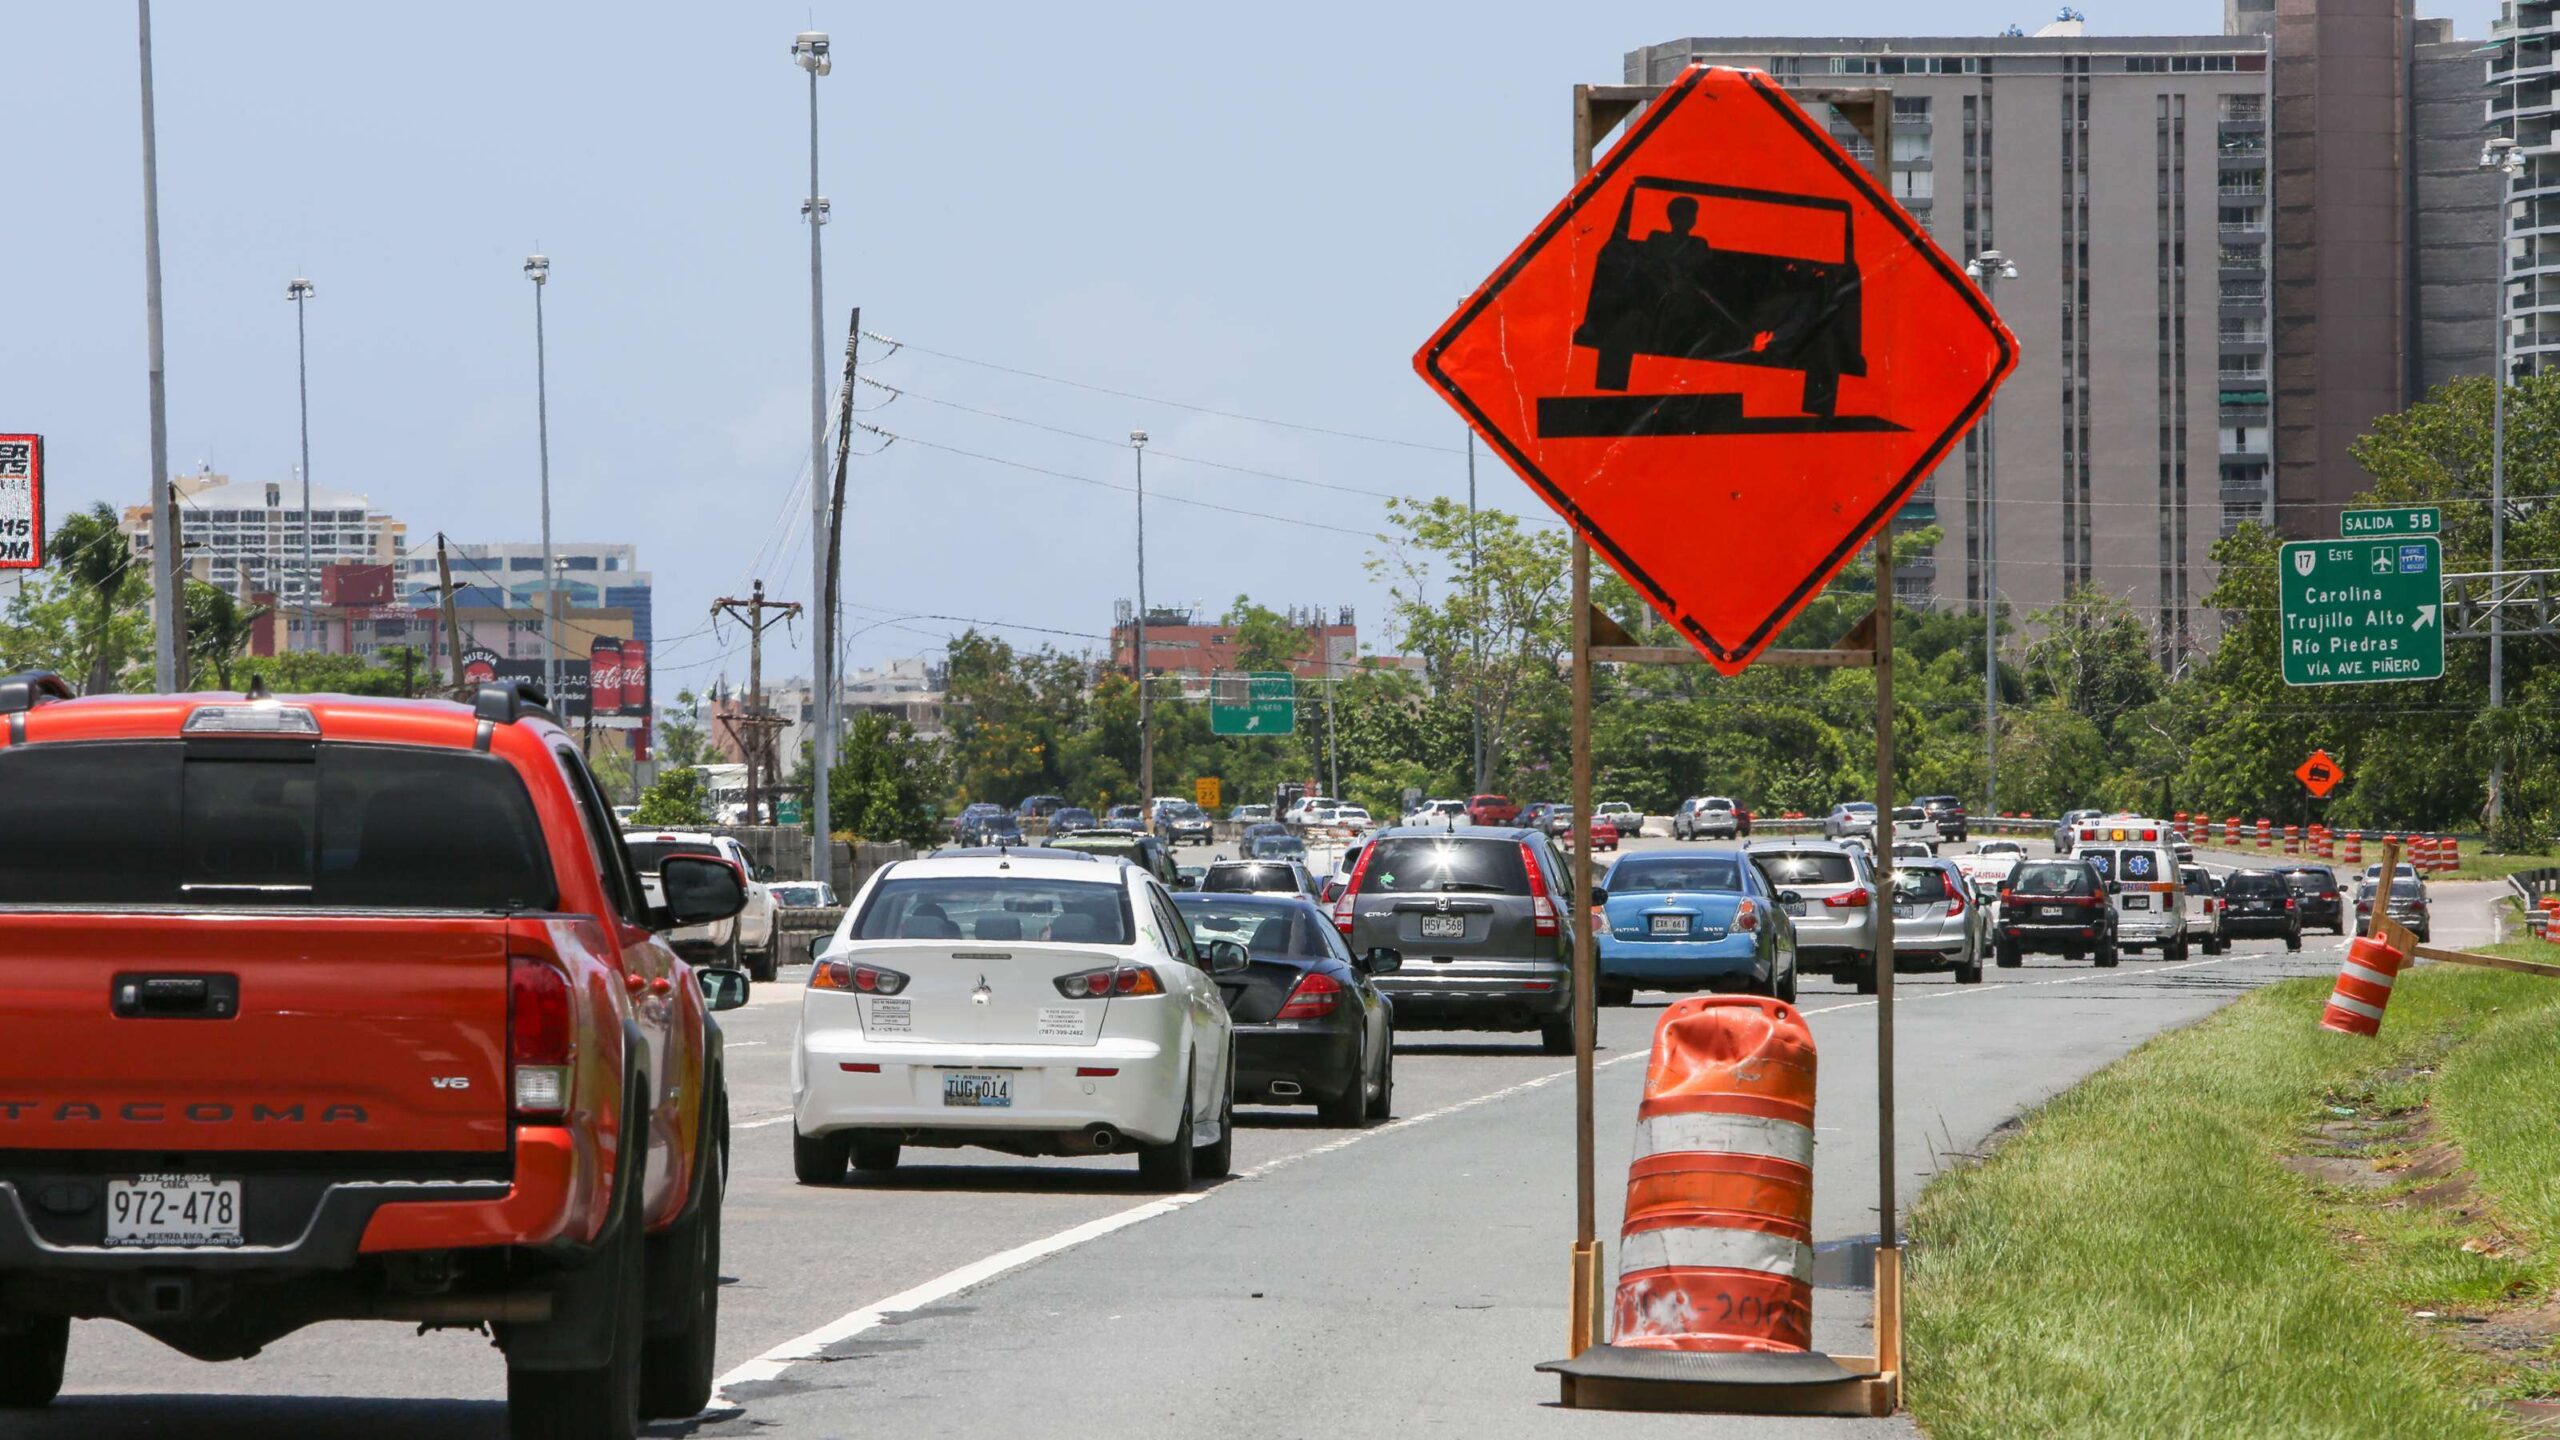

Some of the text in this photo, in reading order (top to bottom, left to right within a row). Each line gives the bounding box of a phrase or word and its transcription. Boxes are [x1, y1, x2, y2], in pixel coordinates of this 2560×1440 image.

[2345, 514, 2432, 531] SALIDA 5B
[2298, 554, 2312, 569] 17
[2305, 586, 2382, 604] Carolina
[2286, 610, 2405, 633] Trujillo Alto
[2292, 636, 2399, 656] Río Piedras
[2306, 661, 2331, 677] VÍA
[2372, 657, 2420, 674] PIÑERO
[1446, 919, 1463, 931] 568
[430, 1077, 470, 1089] V6
[982, 1081, 1007, 1099] 014
[0, 1102, 369, 1123] TACOMA
[114, 1190, 233, 1225] 972-478
